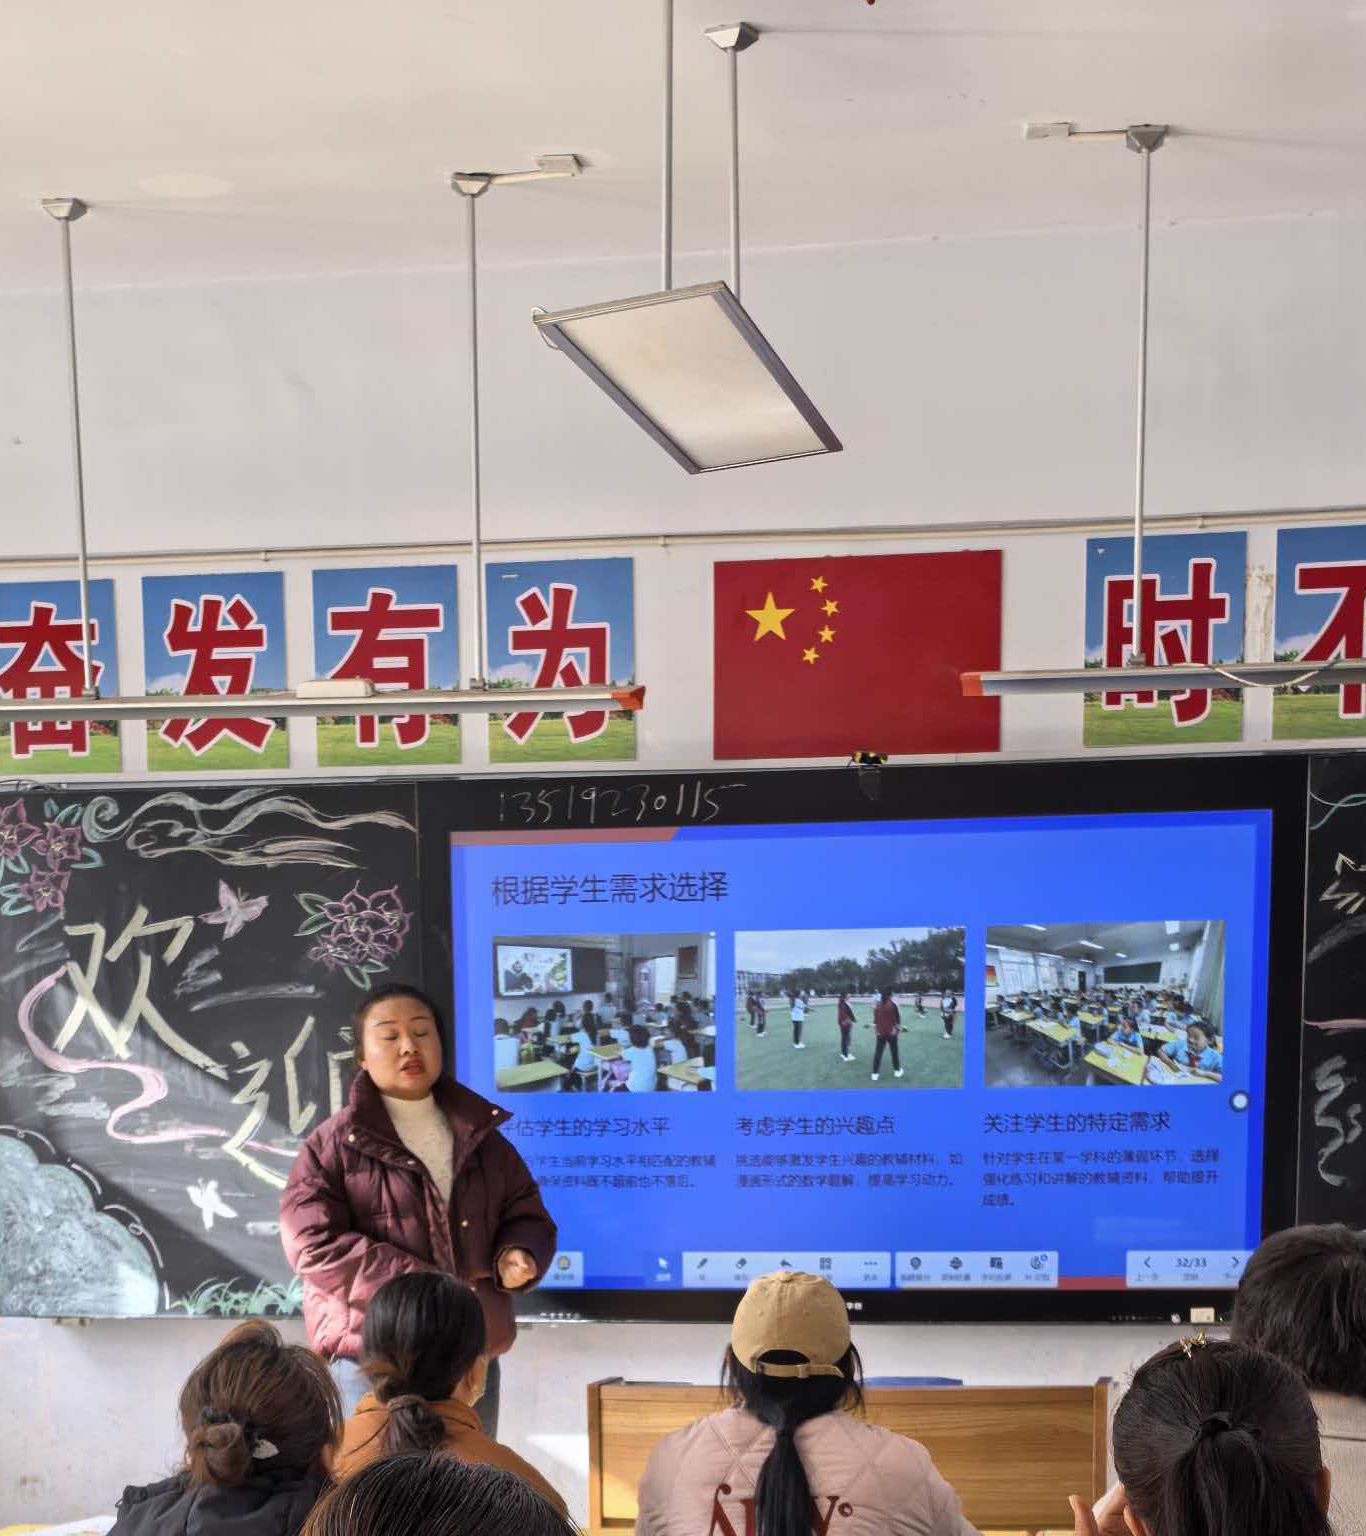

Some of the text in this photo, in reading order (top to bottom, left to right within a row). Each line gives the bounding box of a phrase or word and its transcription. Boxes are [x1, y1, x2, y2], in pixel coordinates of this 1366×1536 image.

[499, 781, 748, 824] 13519230115
[491, 871, 731, 906] 根据学生需求选择
[735, 1115, 896, 1137] 考虑学生的兴趣点
[983, 1111, 1172, 1135] 关注学生的特定需求
